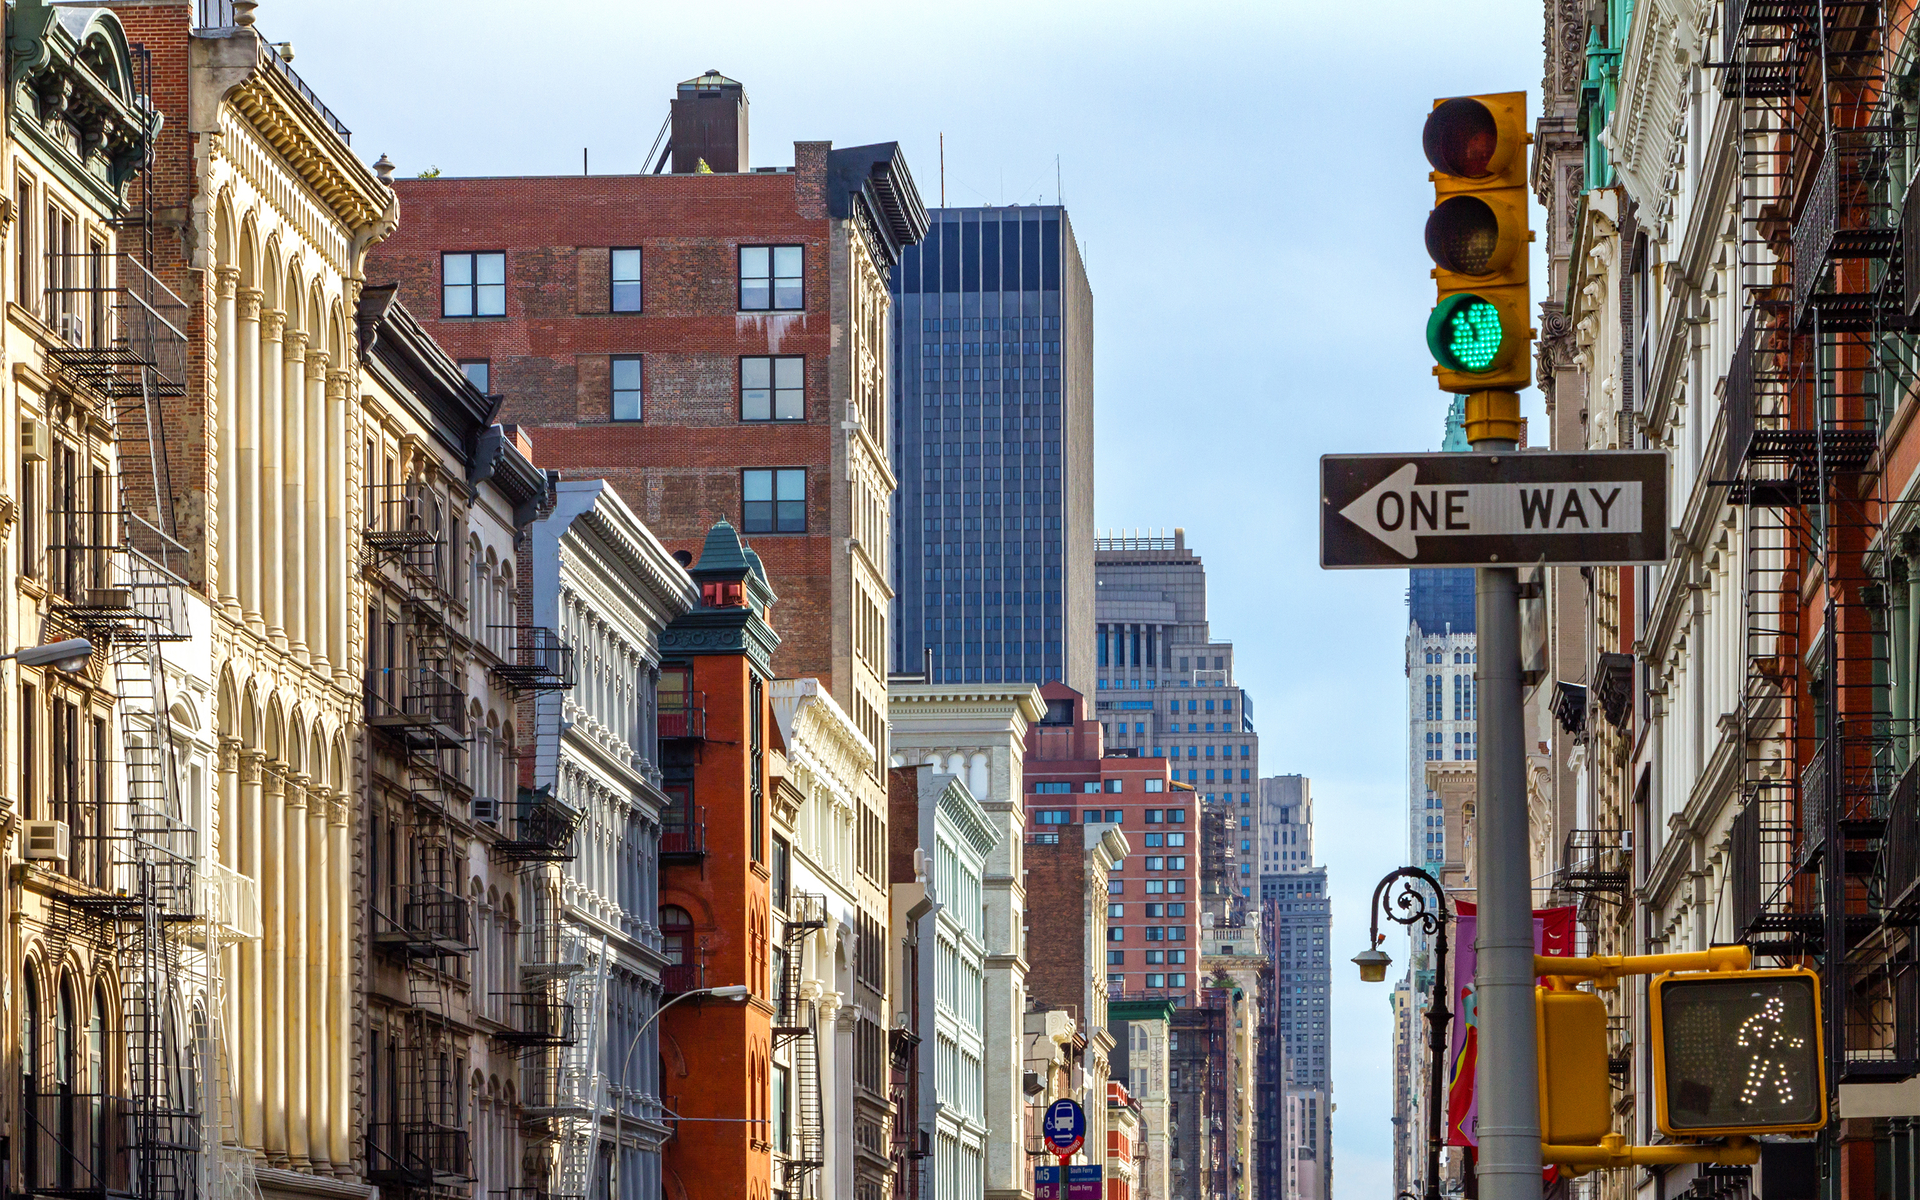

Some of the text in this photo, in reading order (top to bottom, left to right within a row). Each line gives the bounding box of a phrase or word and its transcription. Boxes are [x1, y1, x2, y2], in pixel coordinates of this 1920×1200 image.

[1376, 487, 1622, 532] ONE WAY
[1047, 1140, 1081, 1154] NO STANDING
[1036, 1168, 1050, 1181] M5
[1036, 1185, 1050, 1199] M5
